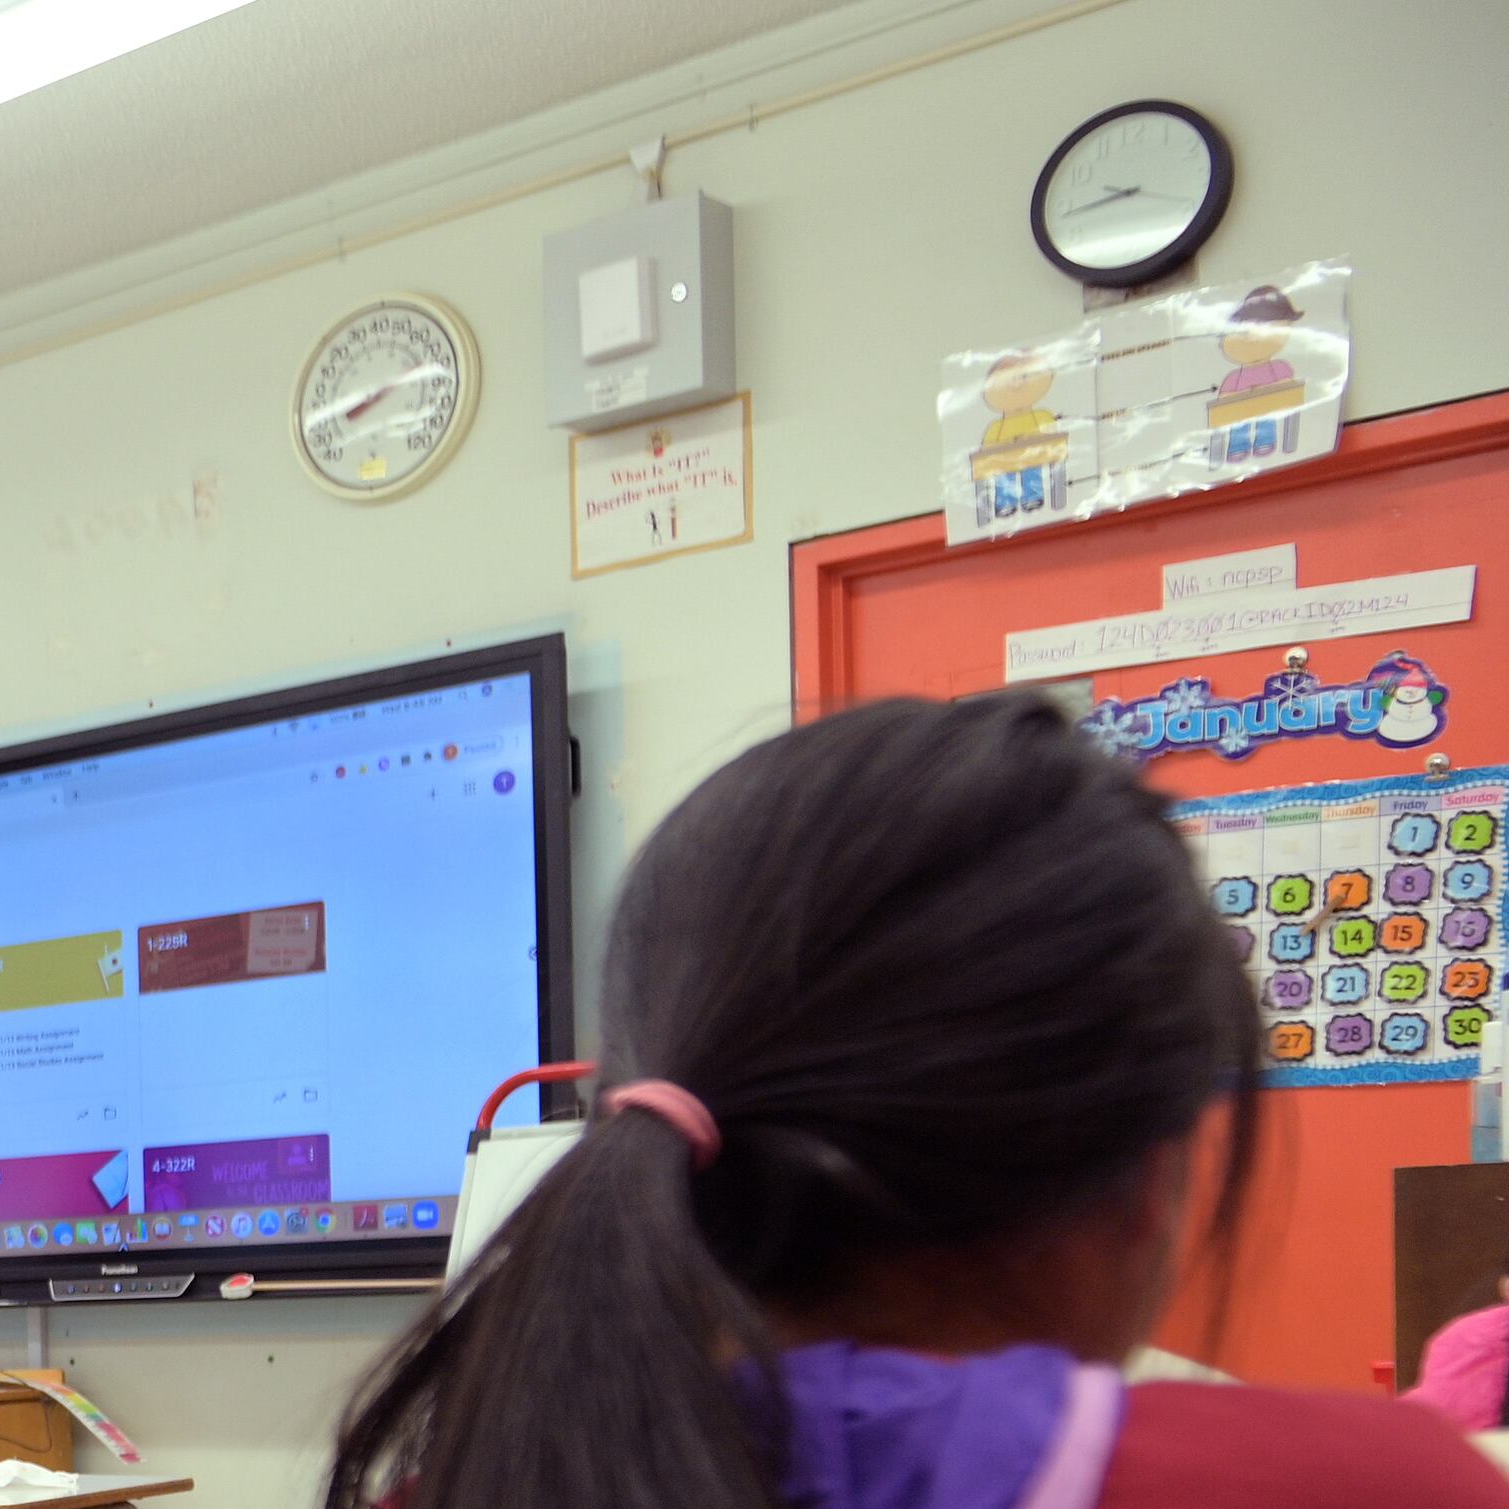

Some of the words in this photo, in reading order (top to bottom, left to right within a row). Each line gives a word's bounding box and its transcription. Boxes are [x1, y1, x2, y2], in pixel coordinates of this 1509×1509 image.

[611, 469, 647, 486] What
[586, 490, 641, 520] Describe
[647, 480, 679, 498] what
[1137, 687, 1384, 750] January
[1215, 817, 1257, 830] Tuesday
[1265, 810, 1321, 824] Wednesday
[1324, 805, 1377, 819] Thursday
[1393, 799, 1429, 813] Friday
[1446, 792, 1500, 807] Saturday
[1410, 825, 1418, 841] 1
[1464, 824, 1477, 840] 2
[1227, 888, 1239, 904] 5
[1283, 887, 1295, 903] 6
[1341, 883, 1353, 900] 7
[1402, 876, 1414, 892] 8
[1461, 873, 1474, 890] 9
[1281, 934, 1302, 951] 13
[1341, 929, 1364, 945] 14
[1392, 924, 1413, 941] 15
[1455, 921, 1476, 938] 16
[1277, 981, 1302, 997] 20
[1336, 977, 1356, 993] 21
[1390, 974, 1416, 990] 22
[1453, 971, 1478, 988] 23
[1278, 1032, 1303, 1049] 27
[1338, 1026, 1362, 1043] 28
[1391, 1024, 1416, 1042] 29
[1454, 1017, 1482, 1035] 30
[152, 1155, 196, 1173] 4-322R
